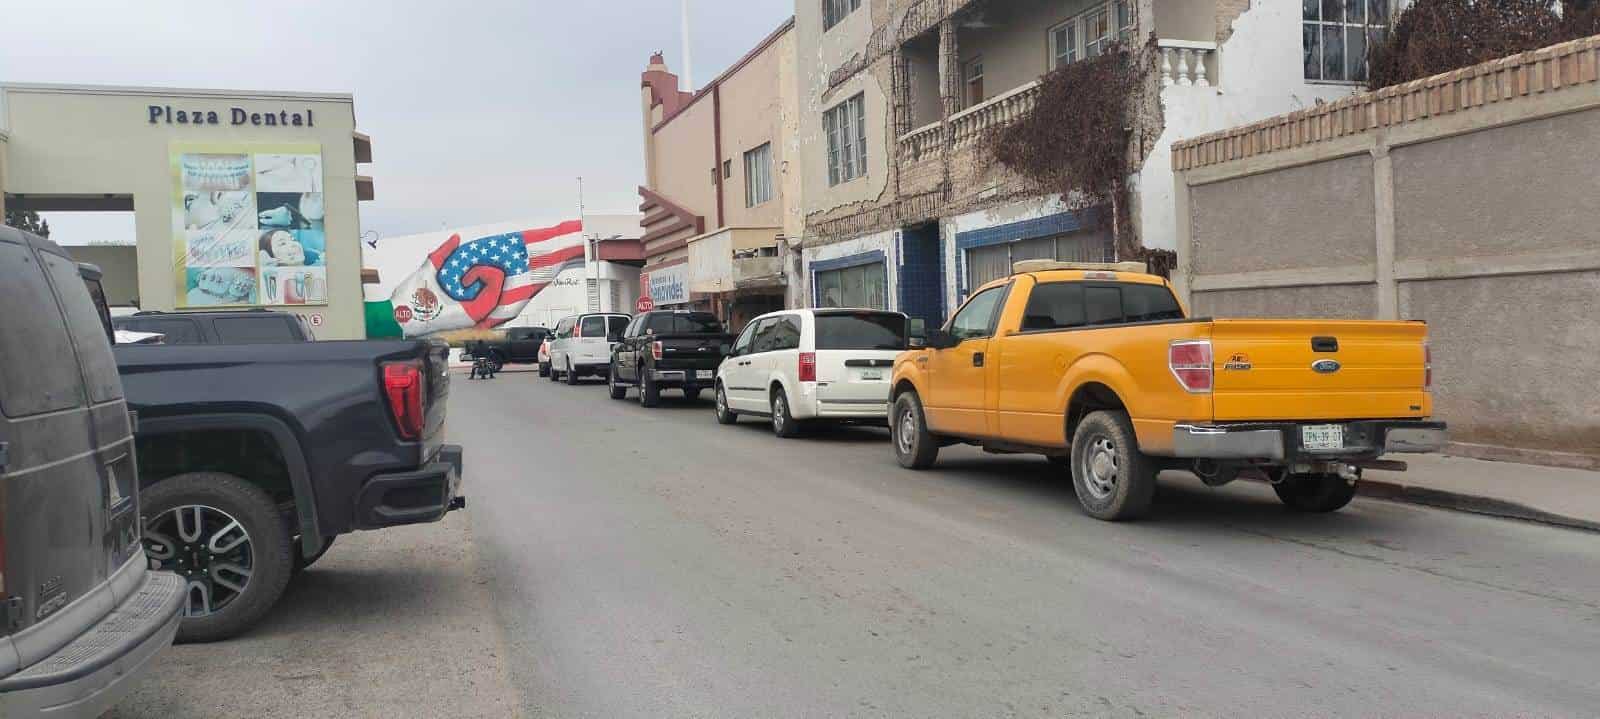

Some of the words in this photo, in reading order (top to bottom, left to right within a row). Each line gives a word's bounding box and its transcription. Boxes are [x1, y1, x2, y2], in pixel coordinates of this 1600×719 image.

[148, 105, 218, 124] Plaza
[231, 107, 313, 126] Dental
[638, 301, 653, 310] ALTO
[395, 310, 411, 318] ALTO
